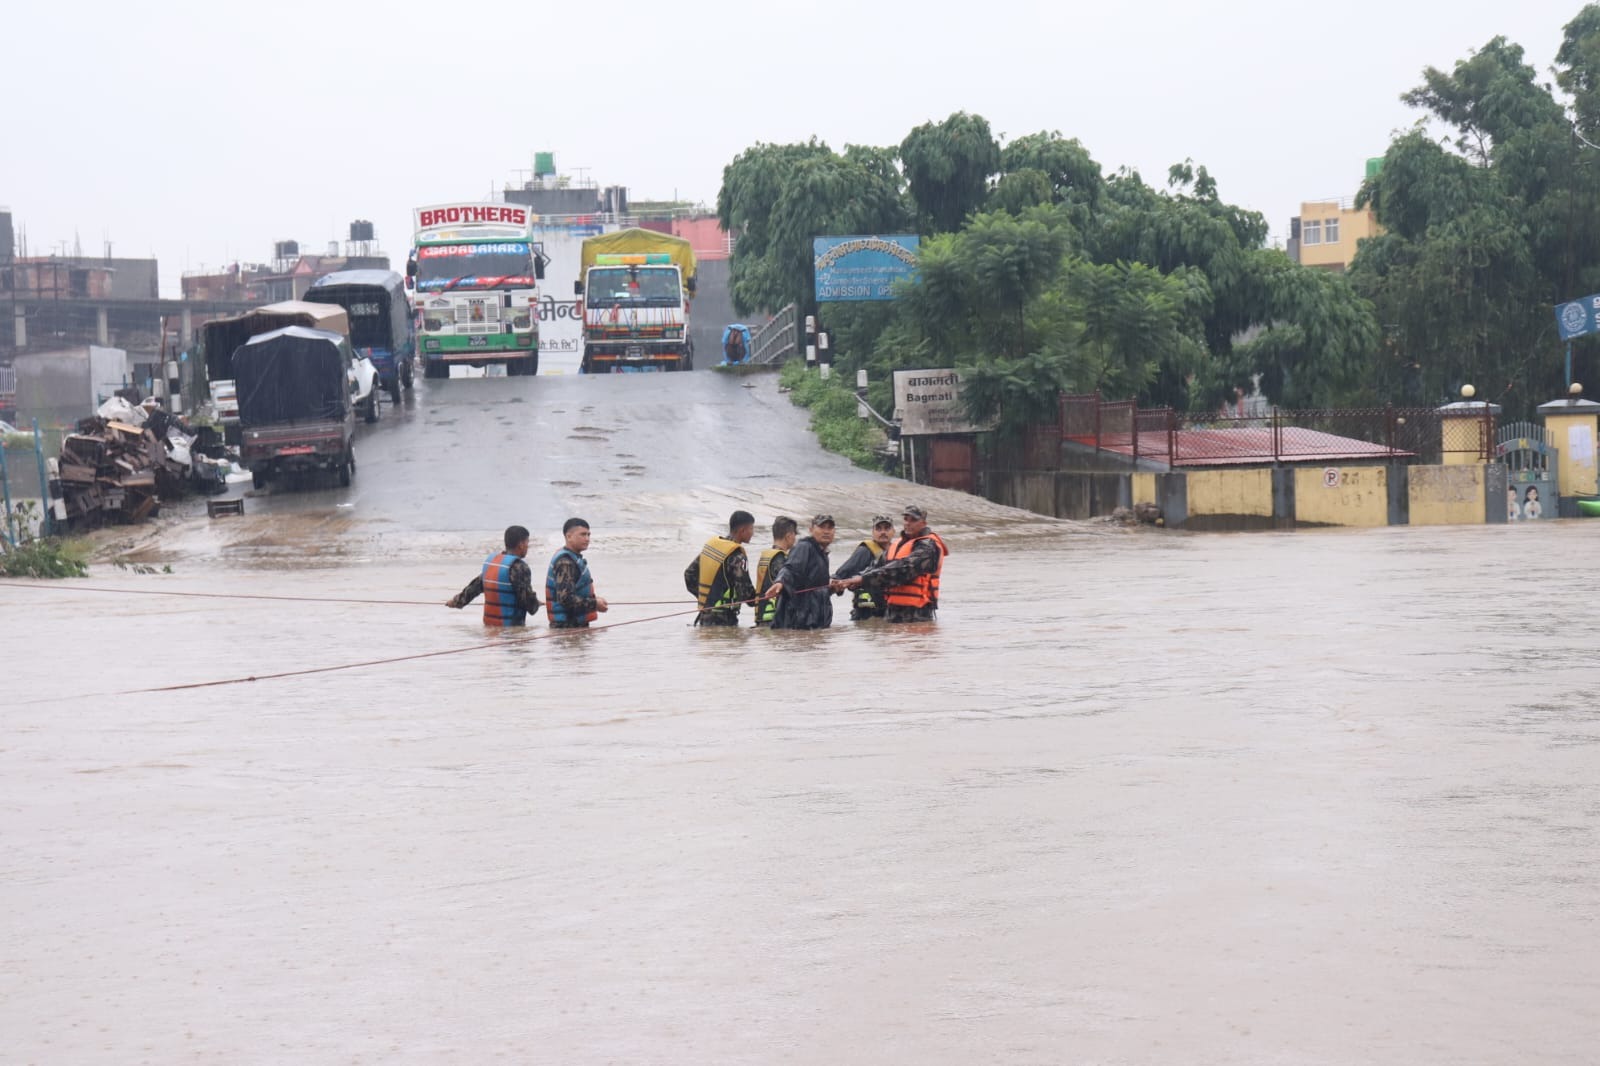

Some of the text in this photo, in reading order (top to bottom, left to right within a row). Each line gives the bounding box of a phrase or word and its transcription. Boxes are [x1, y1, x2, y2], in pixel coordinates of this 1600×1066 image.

[420, 206, 526, 227] BROTHERS
[819, 287, 870, 298] ADMISSION
[906, 392, 953, 404] Bagmati
